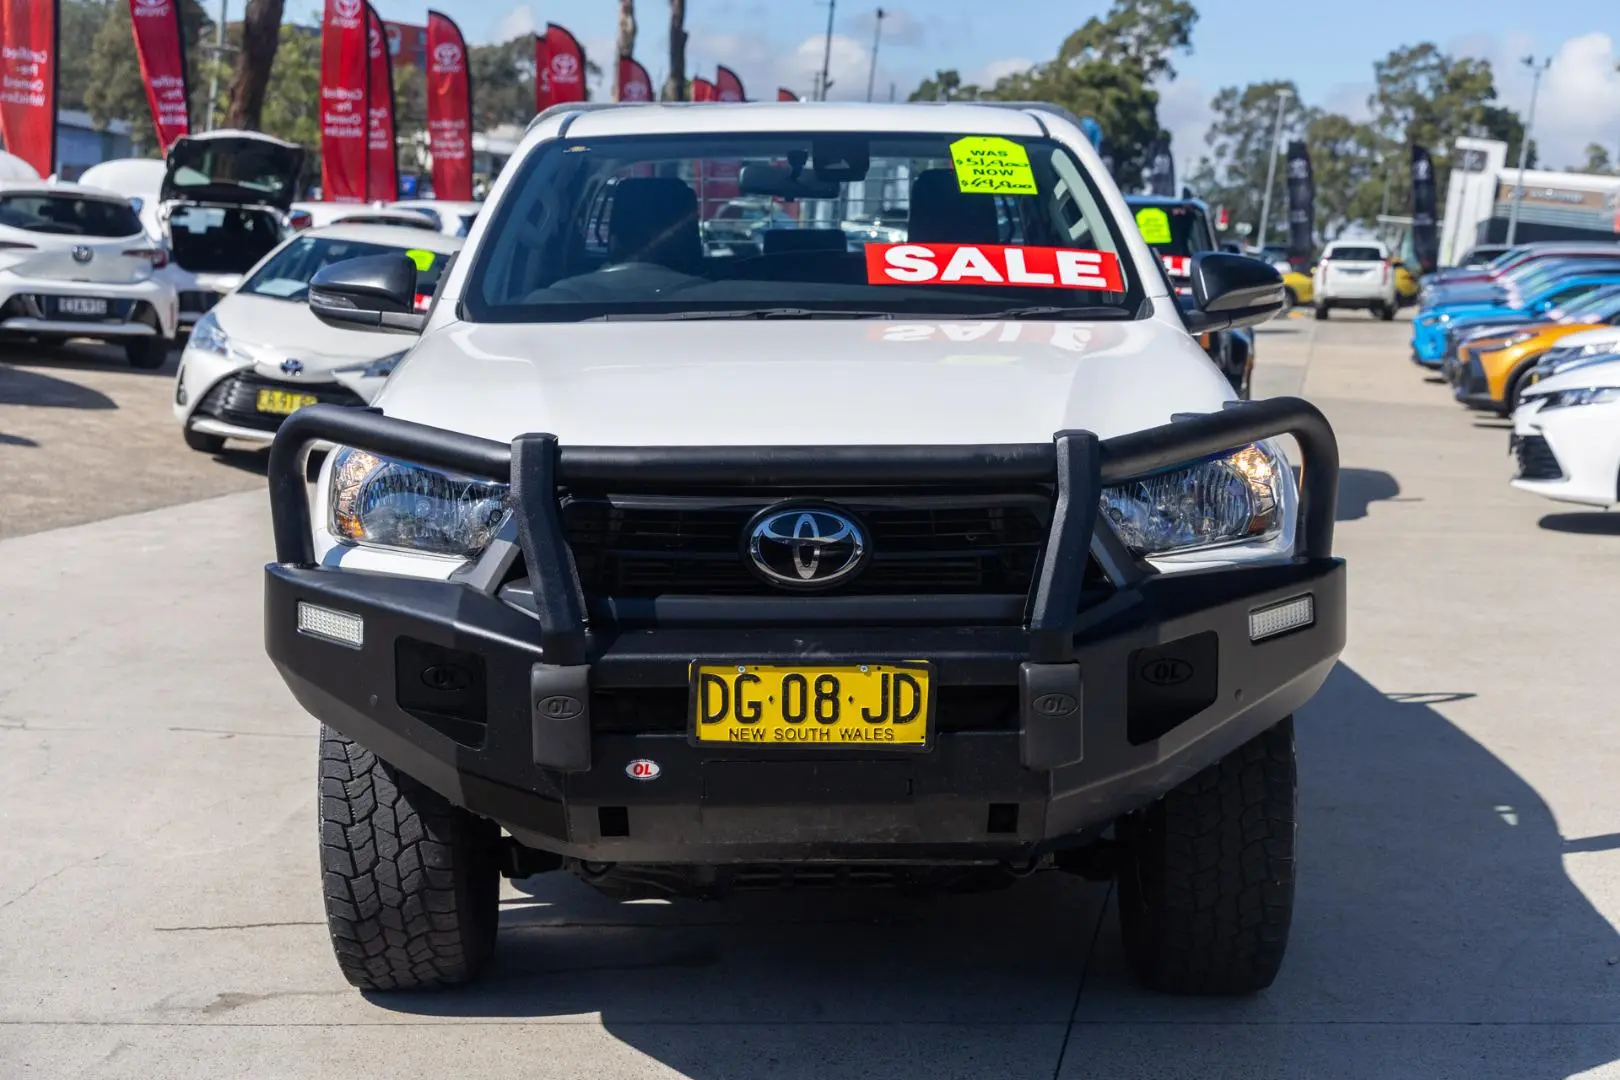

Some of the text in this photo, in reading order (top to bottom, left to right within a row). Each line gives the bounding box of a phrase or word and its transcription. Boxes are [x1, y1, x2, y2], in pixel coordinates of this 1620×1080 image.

[973, 168, 1013, 176] NOW
[884, 245, 1107, 288] SALE
[729, 728, 894, 741] NEW SOUTH WALES
[633, 763, 652, 775] OL
